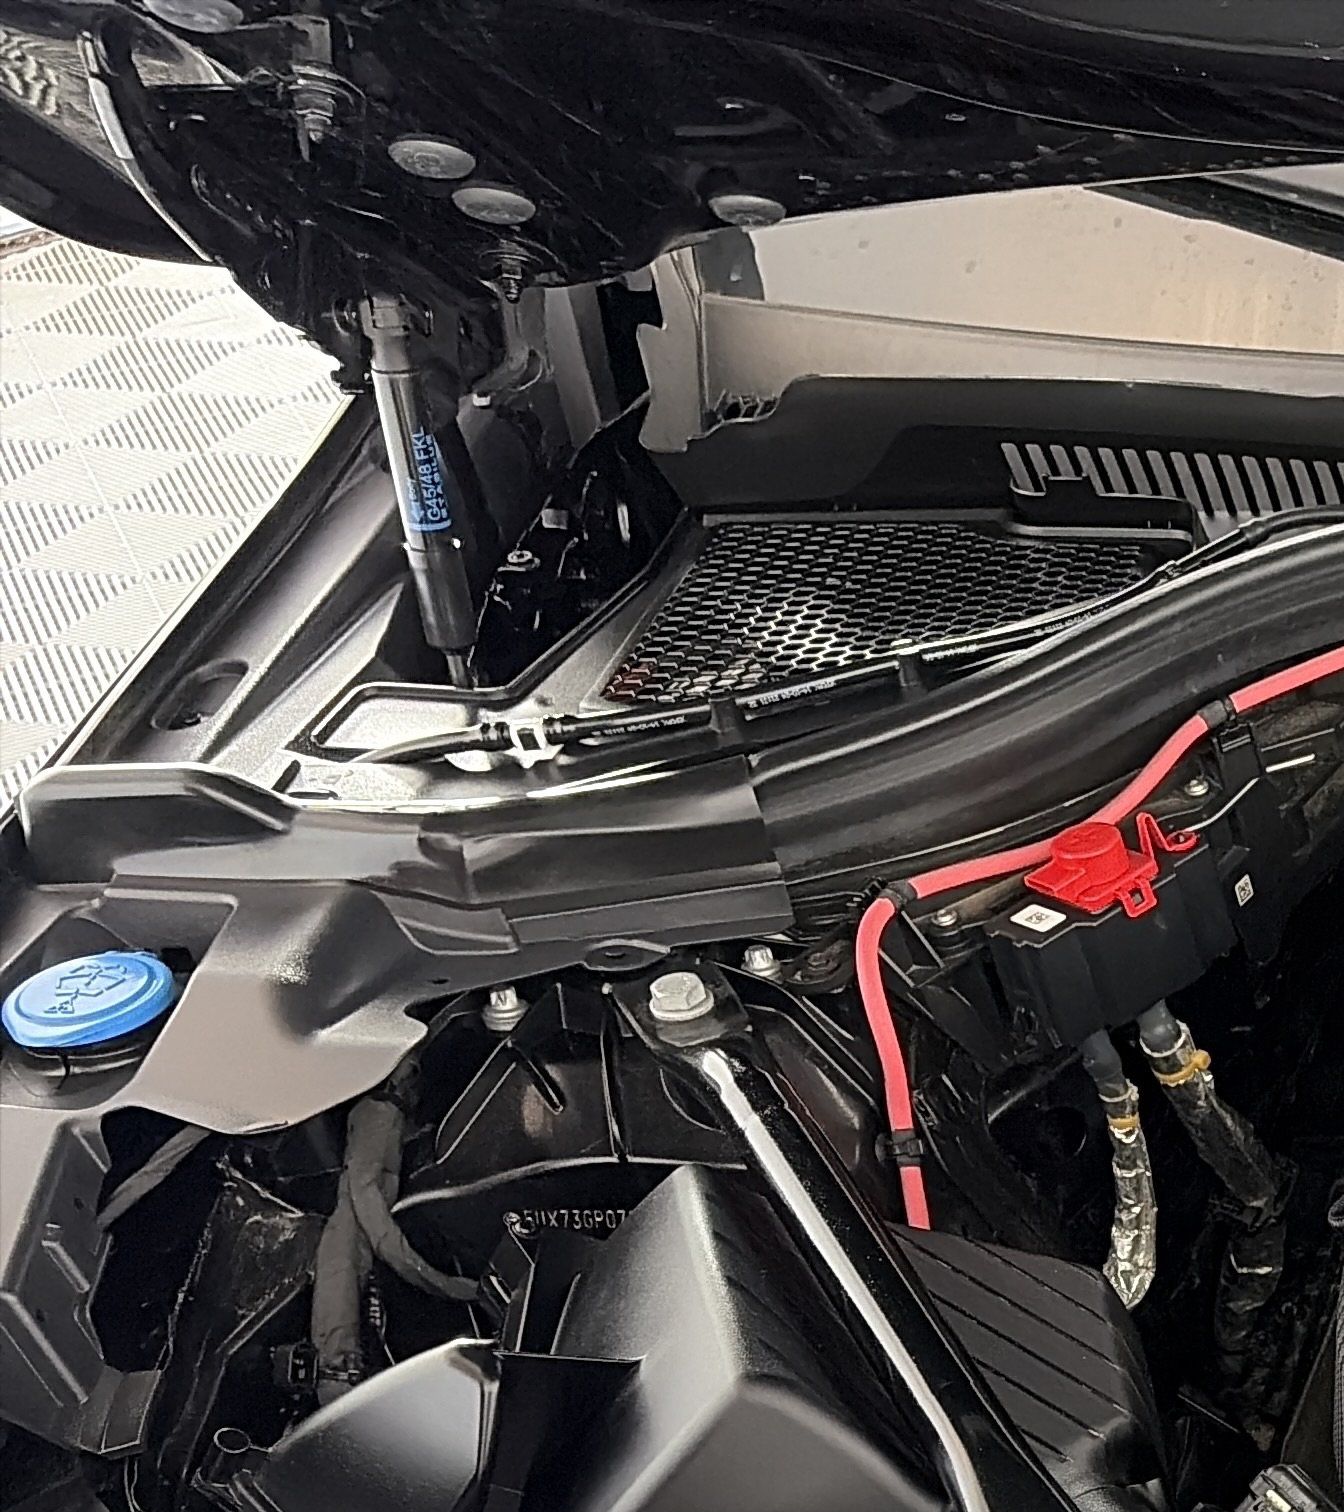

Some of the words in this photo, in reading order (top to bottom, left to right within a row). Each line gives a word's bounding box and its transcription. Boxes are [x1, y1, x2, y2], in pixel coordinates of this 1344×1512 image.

[410, 425, 429, 461] FKL
[417, 462, 442, 521] G45/48
[523, 1209, 632, 1230] 5UX73GP07
